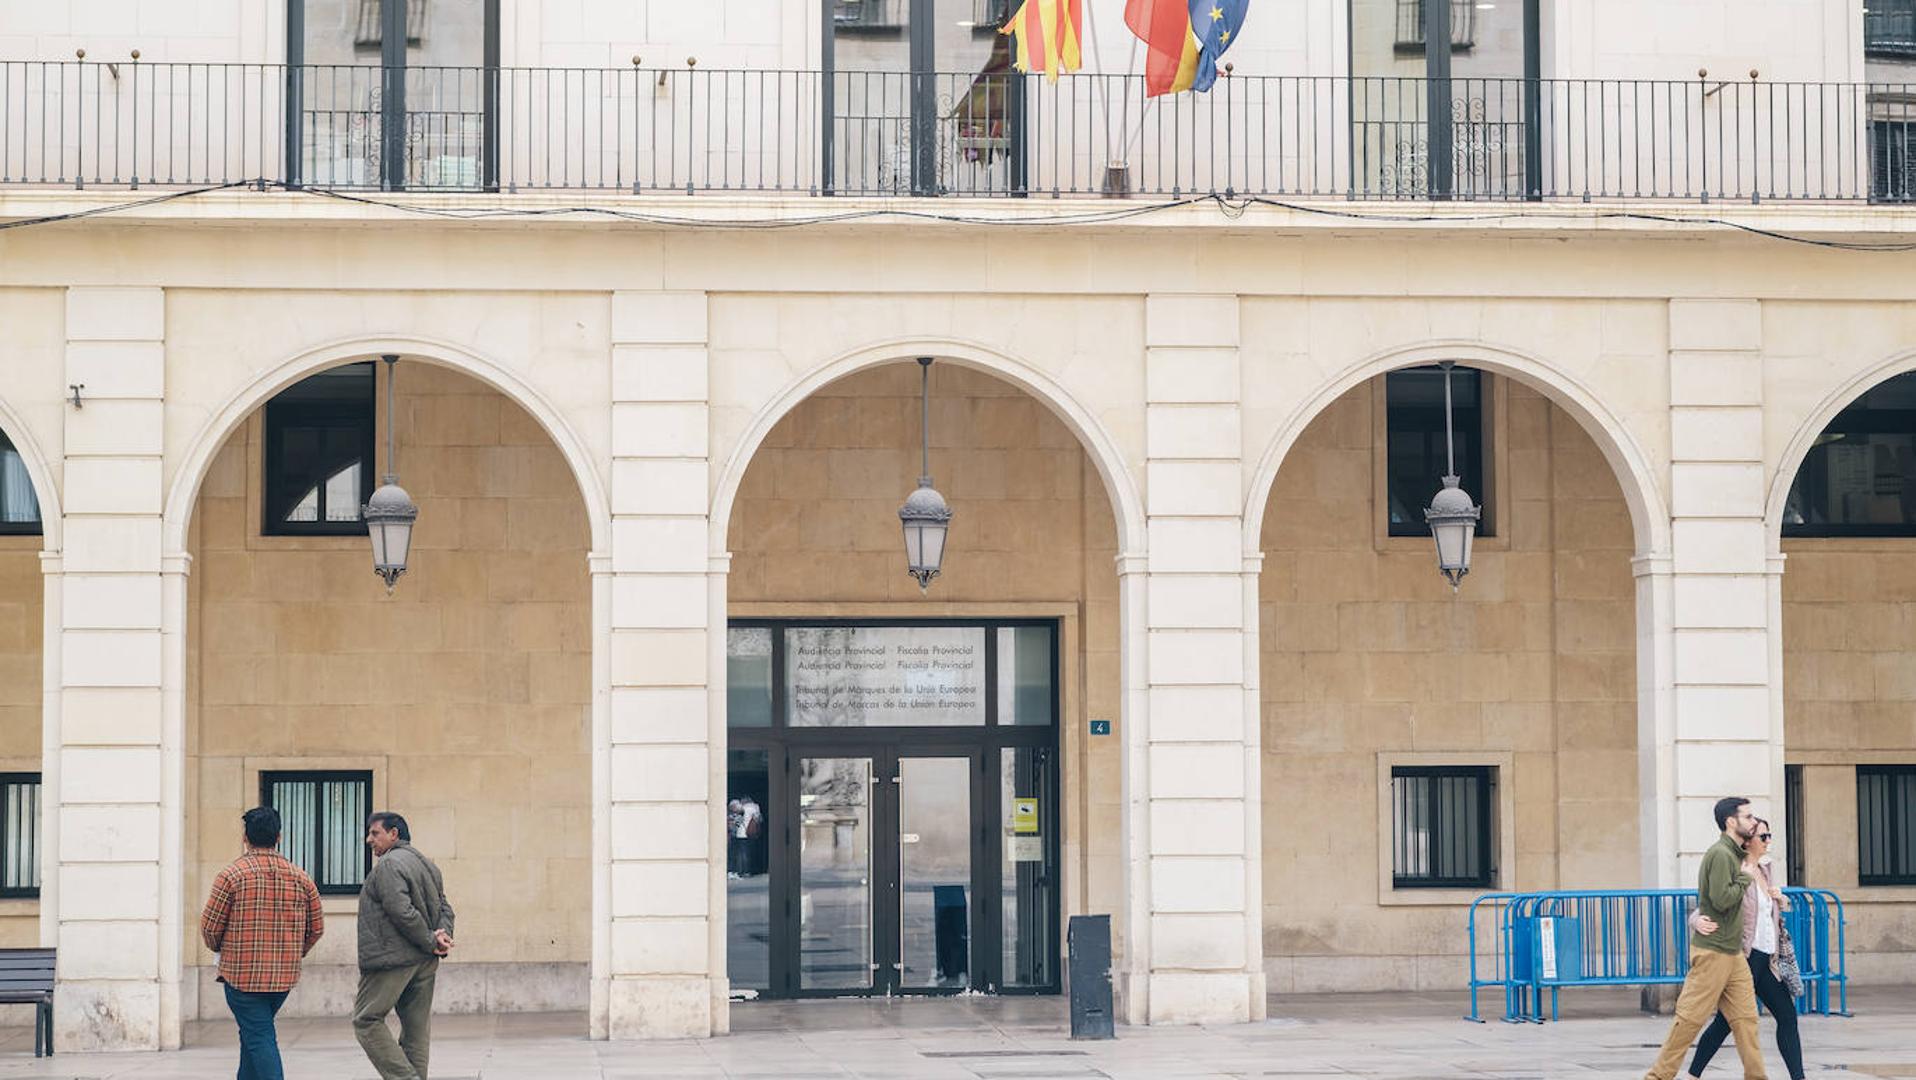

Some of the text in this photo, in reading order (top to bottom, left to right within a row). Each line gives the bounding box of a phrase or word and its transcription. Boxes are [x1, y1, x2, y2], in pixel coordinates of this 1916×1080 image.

[844, 645, 886, 655] Provincial
[932, 645, 974, 655] Provincial
[844, 660, 886, 670] Provincial
[932, 660, 974, 670] Provincial
[832, 685, 844, 694] de
[890, 684, 901, 694] de
[903, 684, 913, 694] la
[940, 684, 976, 696] Europea
[832, 699, 844, 709] de
[848, 699, 880, 709] Marcas
[884, 699, 895, 709] de
[898, 699, 908, 709] la
[938, 699, 976, 711] Europea
[1096, 722, 1104, 733] 4
